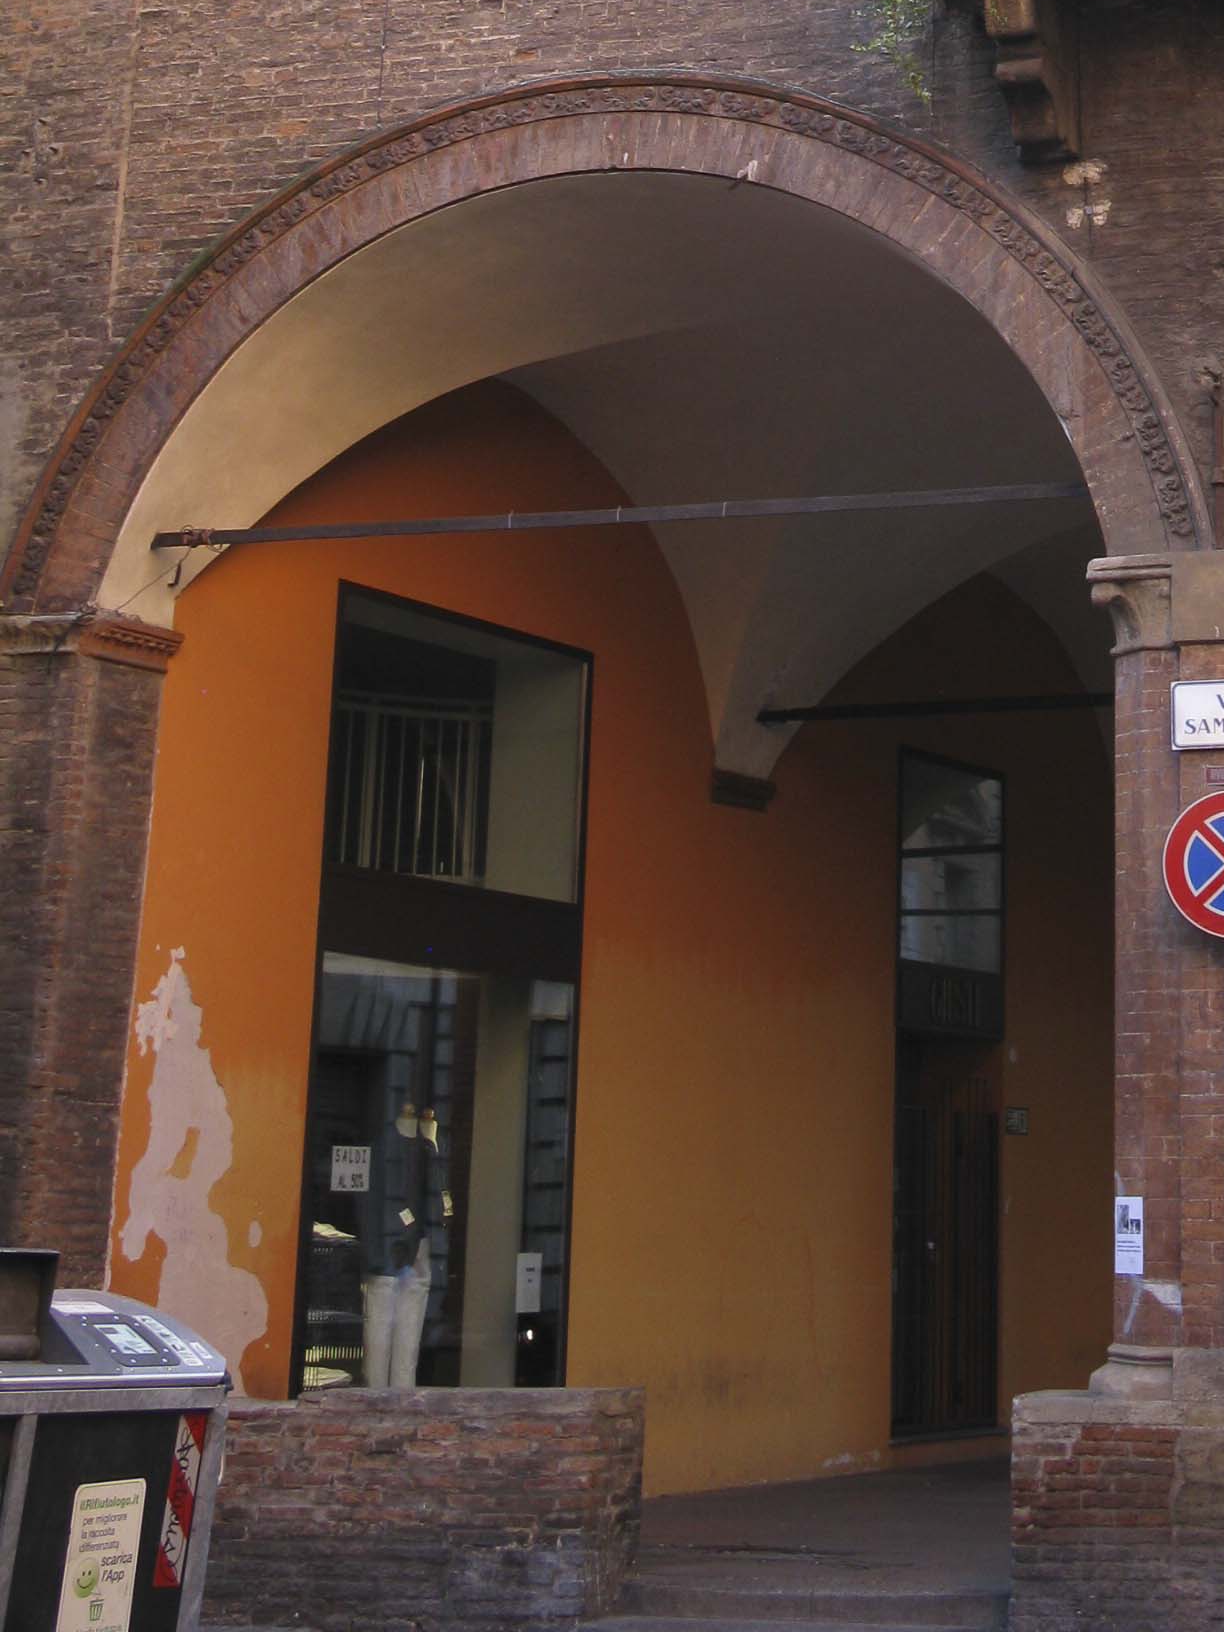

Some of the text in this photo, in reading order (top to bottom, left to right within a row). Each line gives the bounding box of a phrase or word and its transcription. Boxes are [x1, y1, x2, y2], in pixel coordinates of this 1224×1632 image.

[335, 1148, 367, 1164] SALDI
[82, 1512, 127, 1526] per migliorare
[88, 1527, 115, 1539] raccolta
[79, 1540, 119, 1553] differenziata
[101, 1551, 133, 1567] scarica
